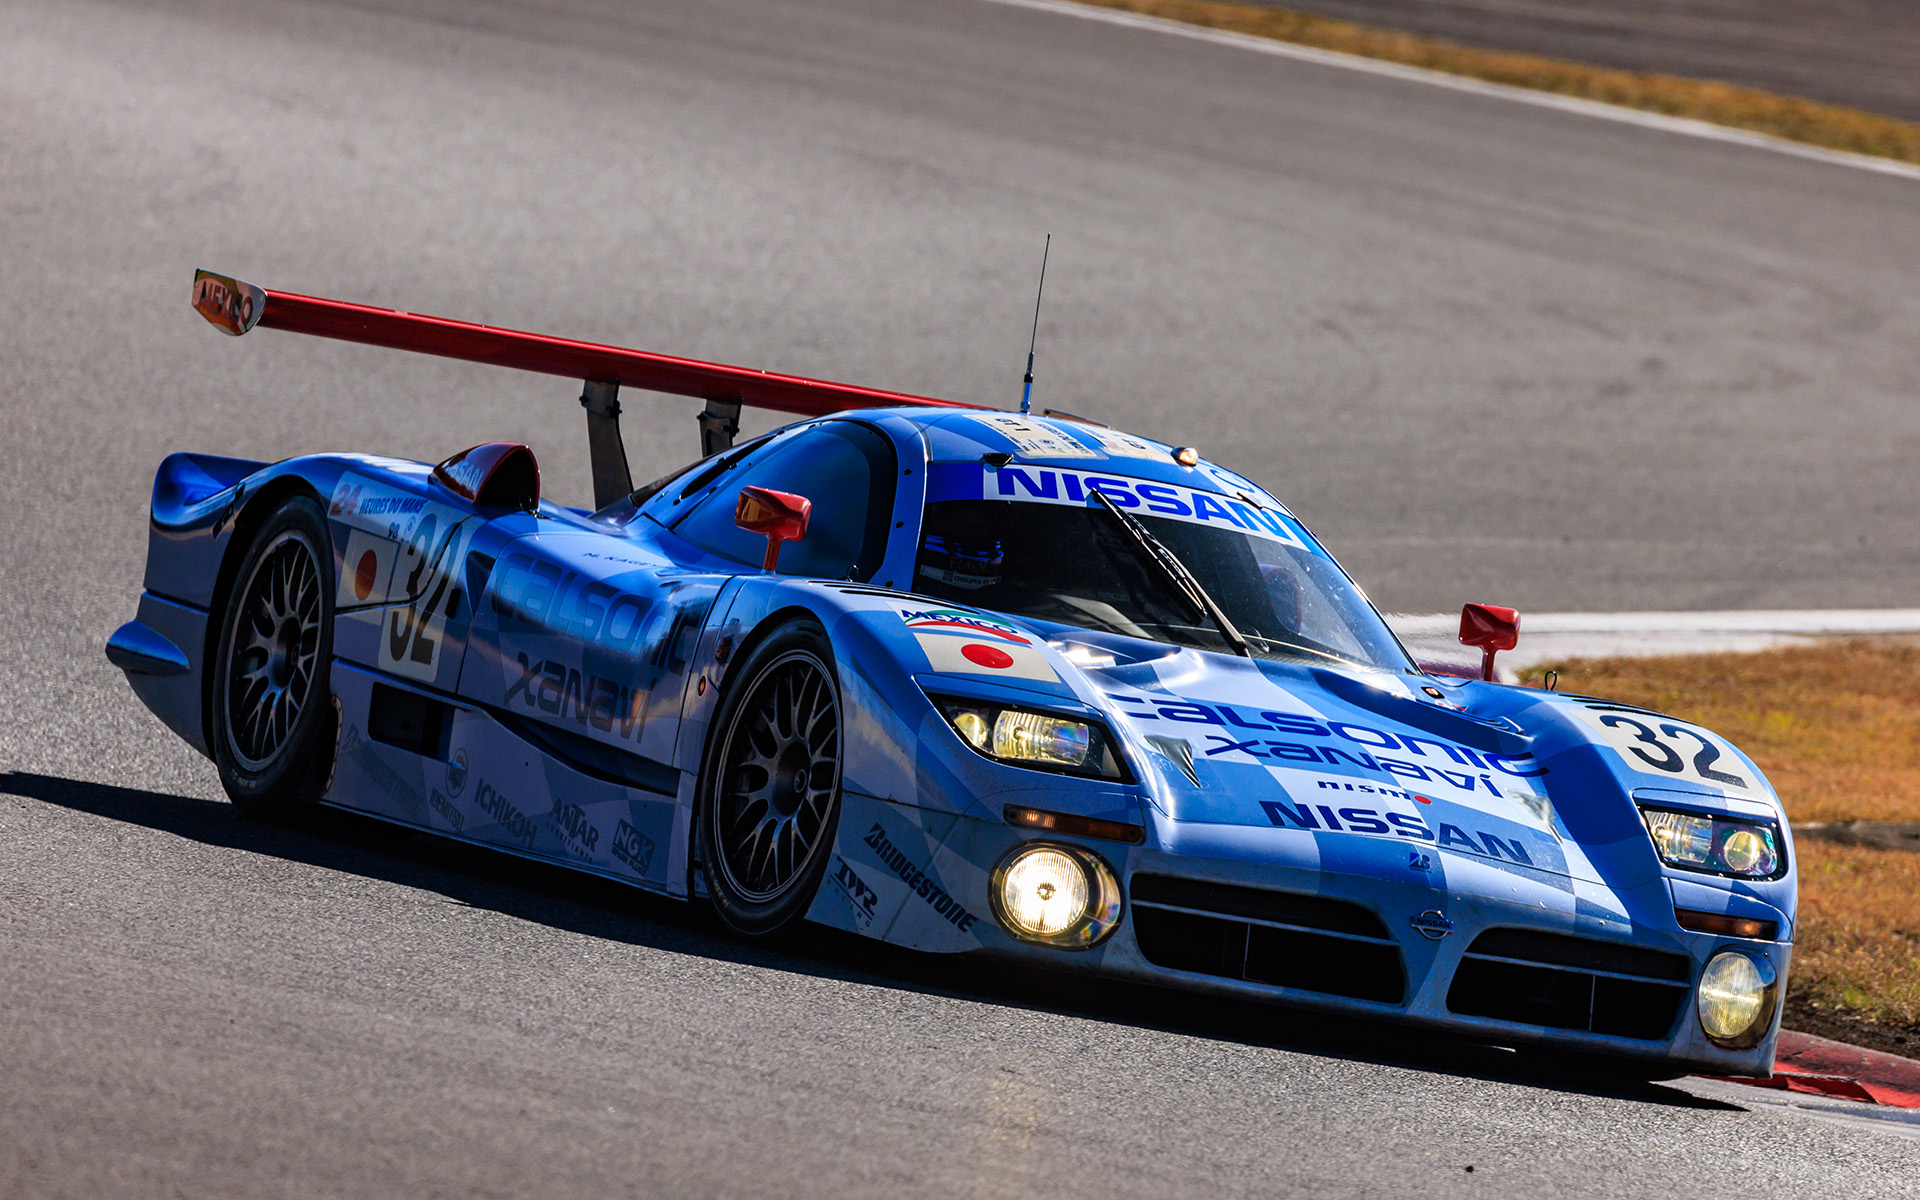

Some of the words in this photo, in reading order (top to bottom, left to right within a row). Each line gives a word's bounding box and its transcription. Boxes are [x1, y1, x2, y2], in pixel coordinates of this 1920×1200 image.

[198, 280, 254, 328] MEXICO
[331, 483, 364, 515] 24
[359, 497, 390, 515] HEURES
[387, 498, 401, 514] DU
[398, 497, 428, 514] MANS
[999, 467, 1294, 542] NISSAN
[388, 522, 401, 539] 98
[389, 512, 468, 666] 32
[901, 609, 1019, 634] MEXICO
[1205, 734, 1504, 799] xanavi
[1599, 714, 1749, 790] 32
[430, 787, 465, 833] IDEMITSU
[474, 778, 538, 849] ICHIKOH
[550, 797, 599, 852] ANTAR
[1263, 800, 1535, 866] NISSAN
[614, 820, 655, 869] NGK
[862, 822, 978, 934] BRIDGESTONE
[1416, 917, 1451, 930] NISSAN
